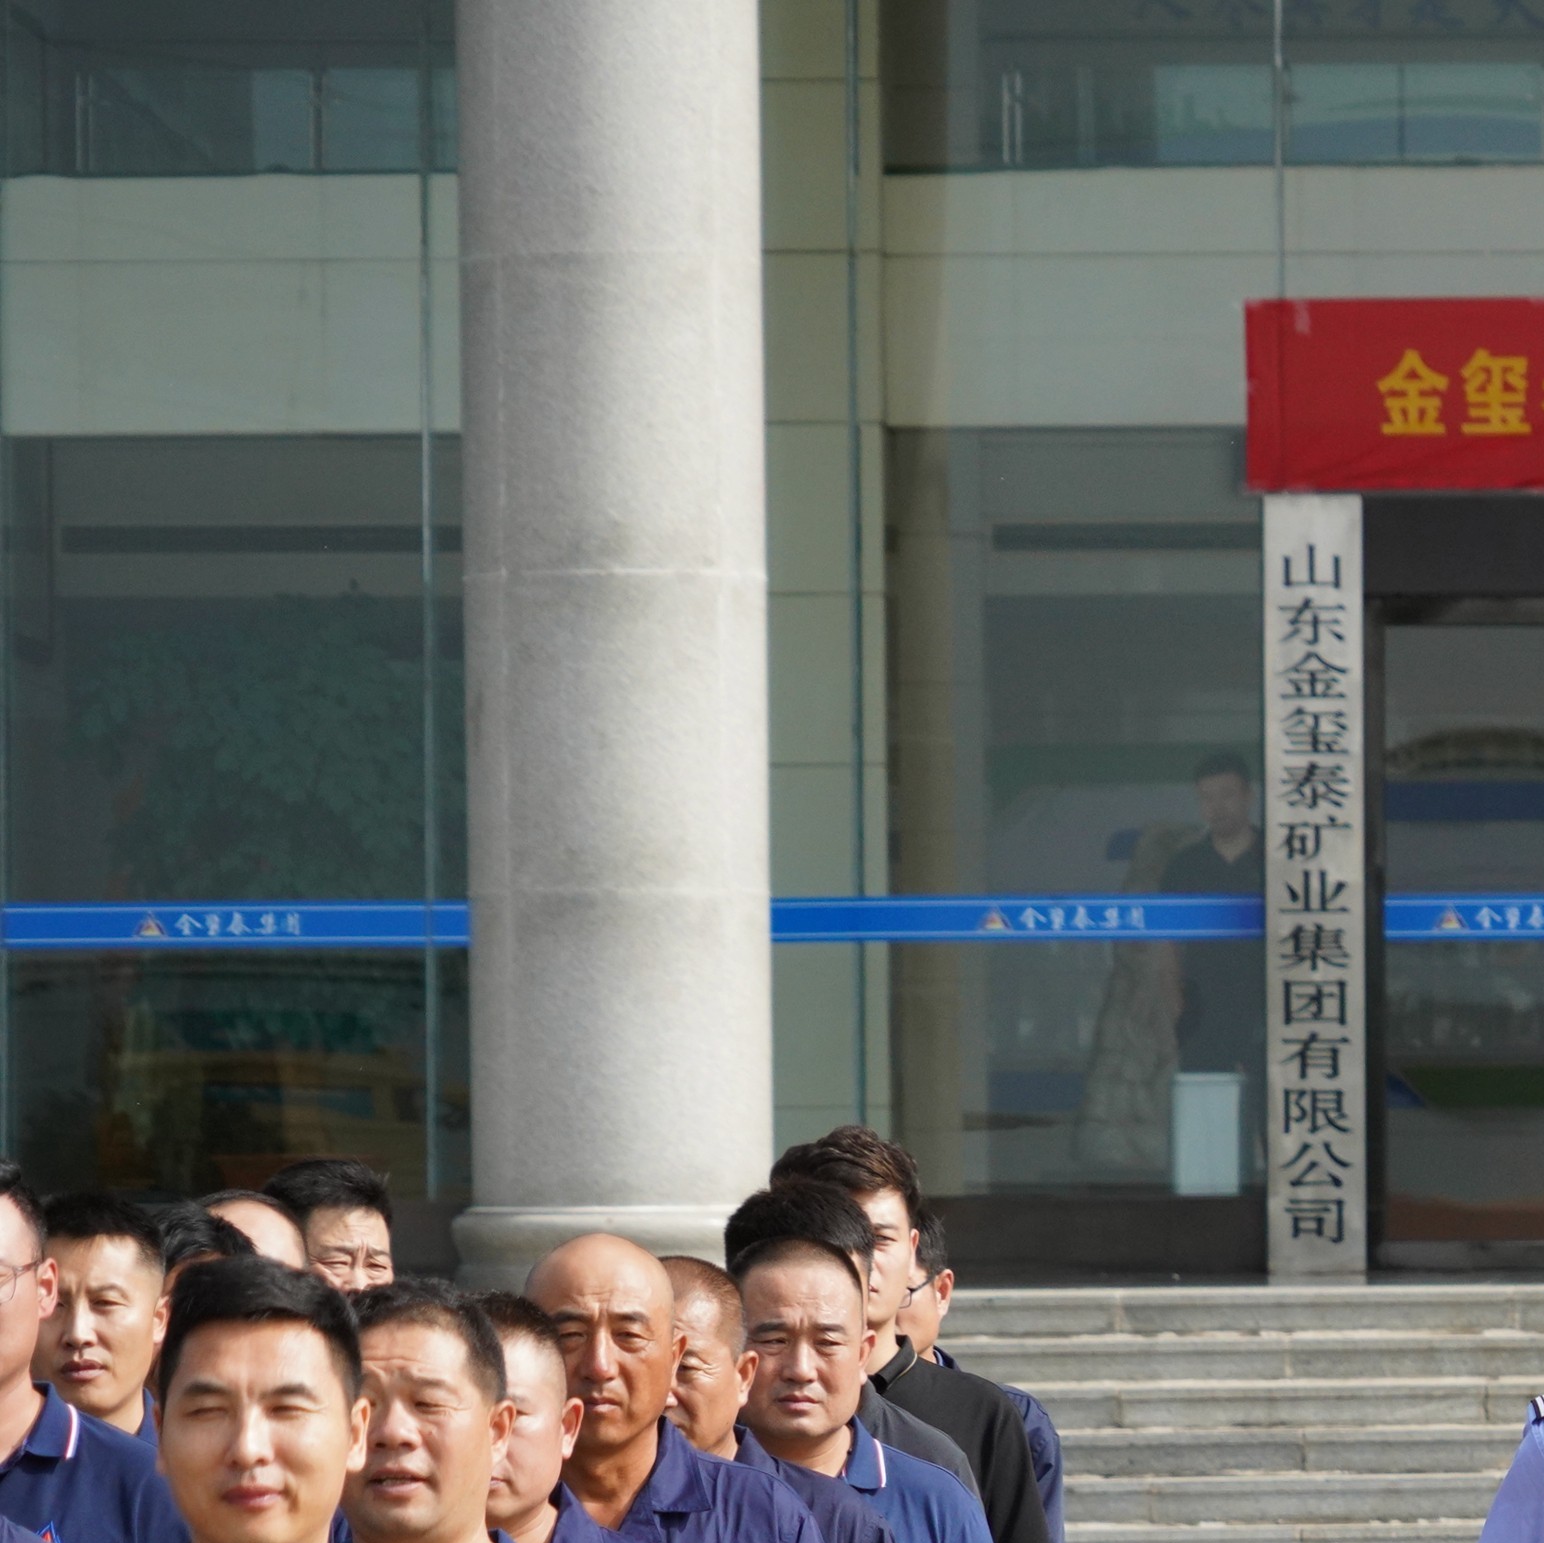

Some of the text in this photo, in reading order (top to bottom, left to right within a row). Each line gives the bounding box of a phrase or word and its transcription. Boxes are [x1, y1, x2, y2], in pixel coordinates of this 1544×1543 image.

[1278, 542, 1352, 1245] 山东金玺泰矿业集团有限公司
